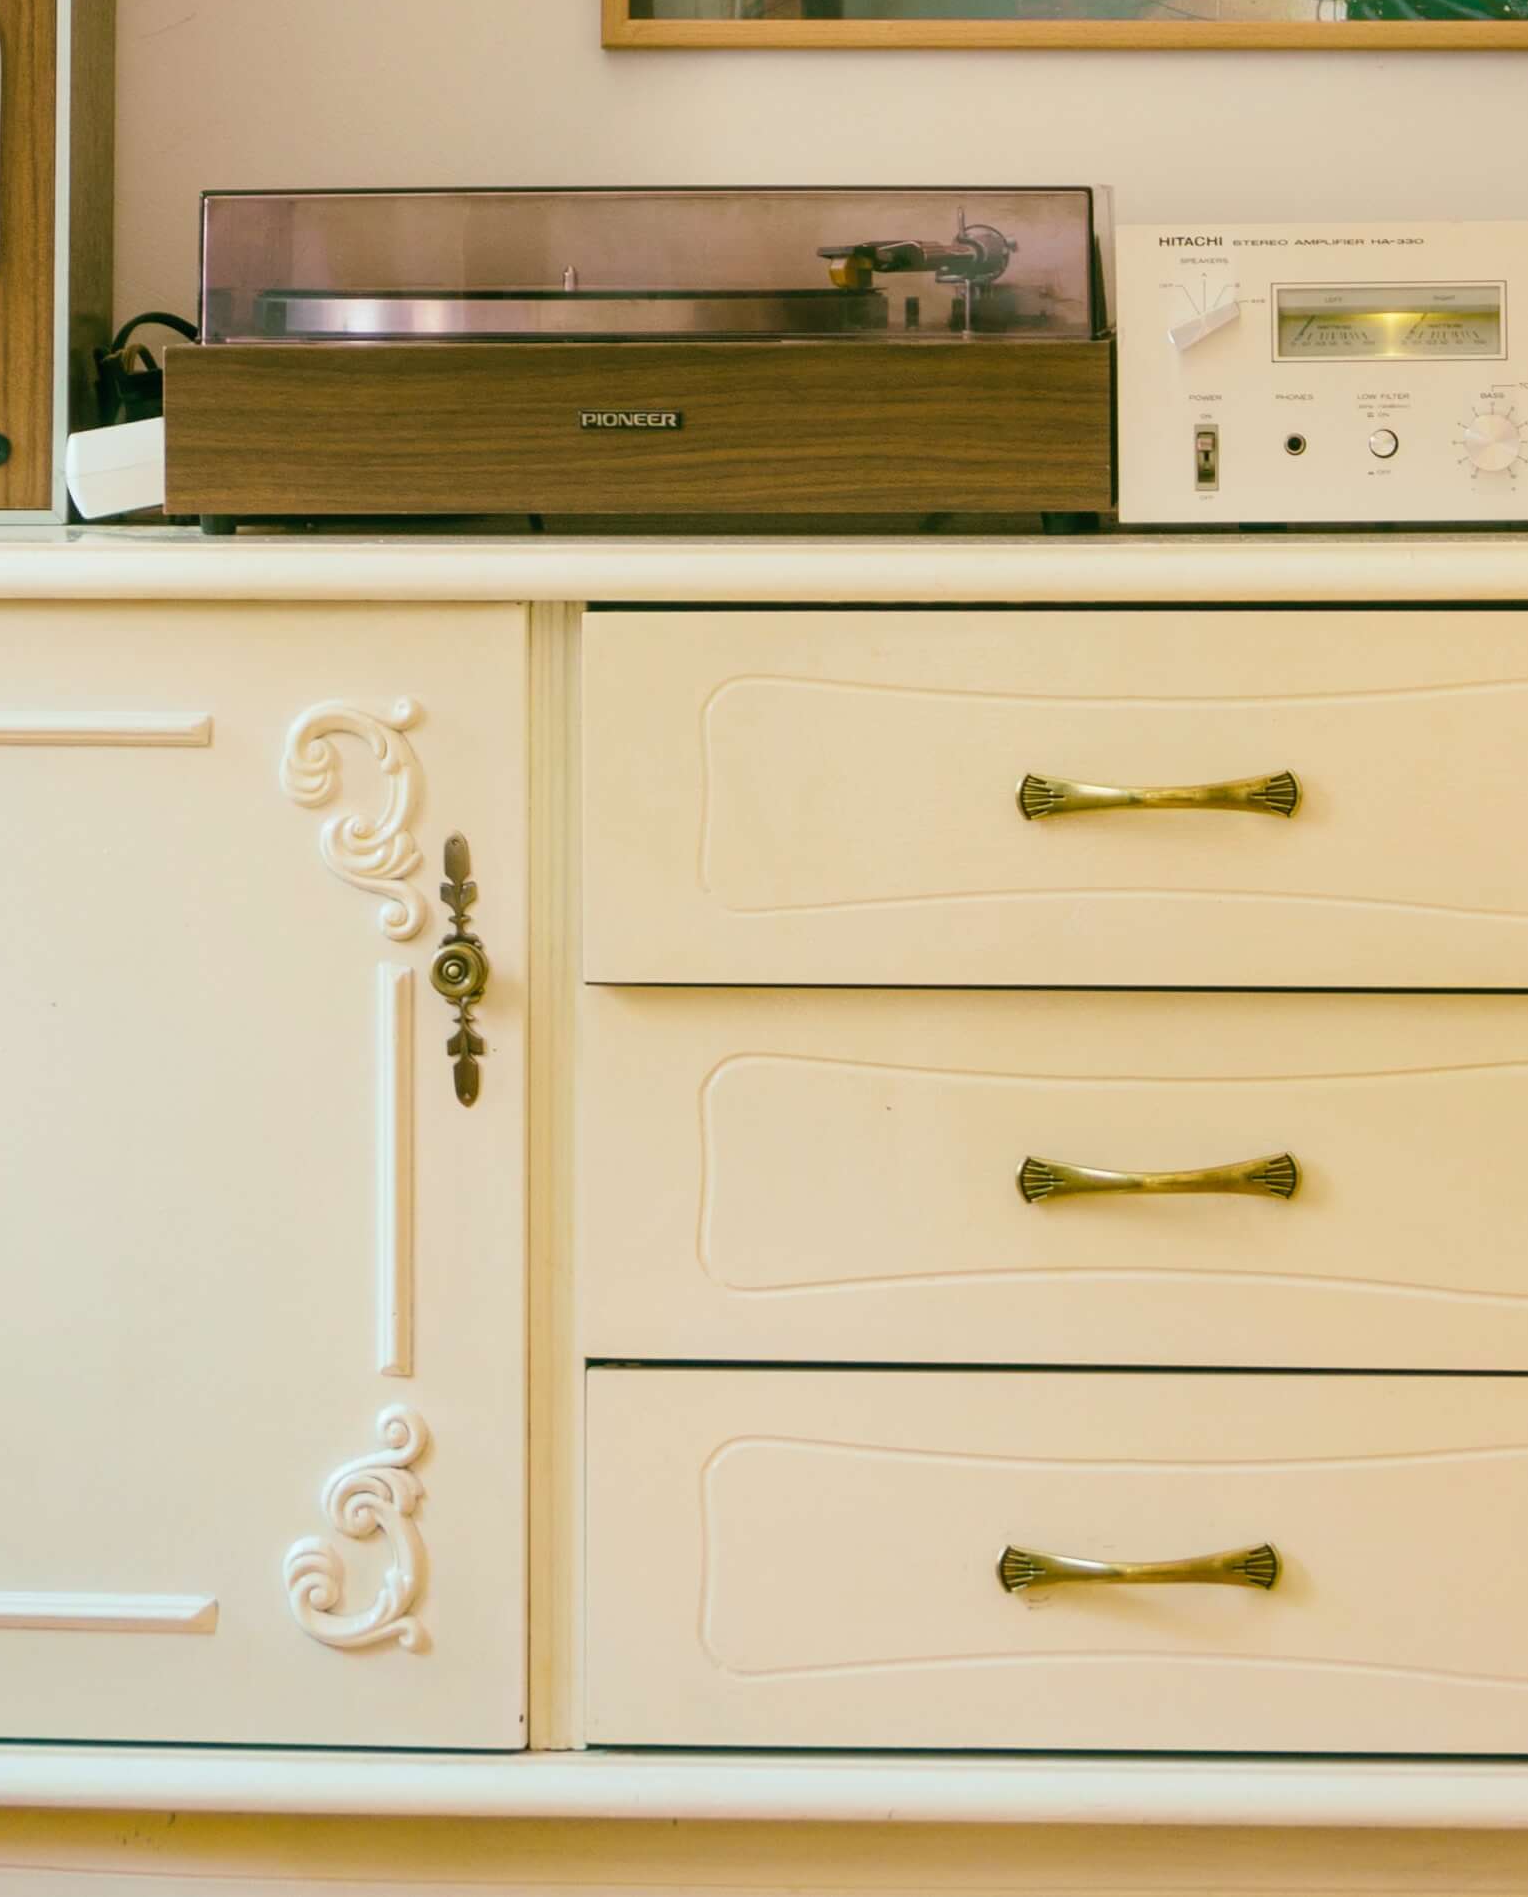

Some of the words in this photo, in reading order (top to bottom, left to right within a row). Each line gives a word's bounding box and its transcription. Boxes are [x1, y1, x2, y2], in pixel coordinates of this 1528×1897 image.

[1158, 236, 1223, 247] HITACHI
[1294, 238, 1365, 246] AMPLIFIER
[1179, 257, 1229, 265] SPEAKERS
[1275, 393, 1314, 401] PHONES
[1380, 392, 1410, 400] FILTER
[582, 413, 677, 426] PIONEER
